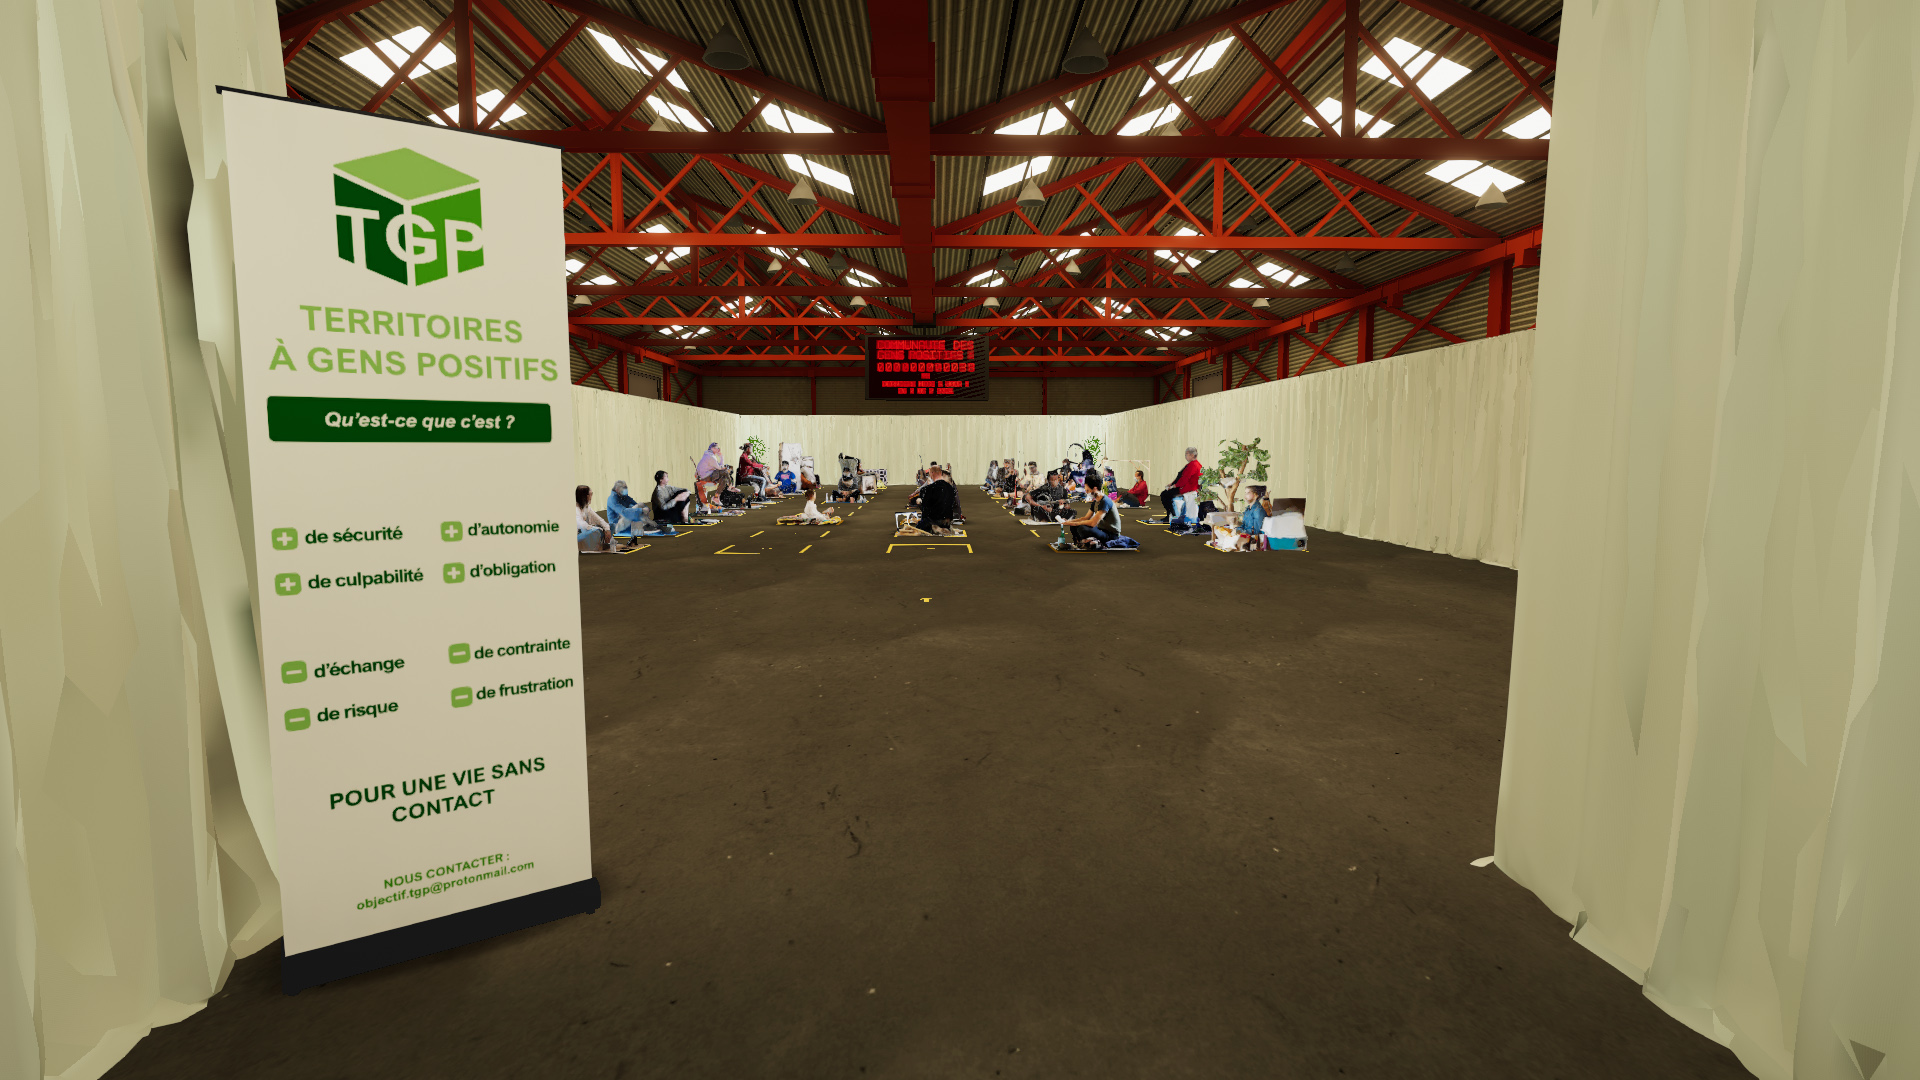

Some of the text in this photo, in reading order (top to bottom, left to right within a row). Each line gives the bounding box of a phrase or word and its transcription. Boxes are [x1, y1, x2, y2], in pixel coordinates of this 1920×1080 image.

[335, 204, 485, 272] TGP
[300, 305, 522, 343] TERRITOIRES
[877, 350, 904, 360] GENS
[953, 340, 974, 350] DES
[269, 339, 558, 381] À GENS POSITIFS
[422, 417, 456, 431] que
[506, 415, 515, 428] ?
[305, 526, 403, 544] de sécurité
[308, 568, 424, 589] de culpabilité
[474, 638, 570, 659] de contrainte
[476, 677, 573, 700] de frustration
[317, 702, 399, 722] de risque
[330, 757, 545, 810] POUR UNE VIE SANS
[392, 789, 495, 822] CONTACT
[384, 871, 422, 890] NOUS
[426, 854, 503, 880] CONTACTER
[357, 862, 534, 910] objectif.tgp@protonmail.com
